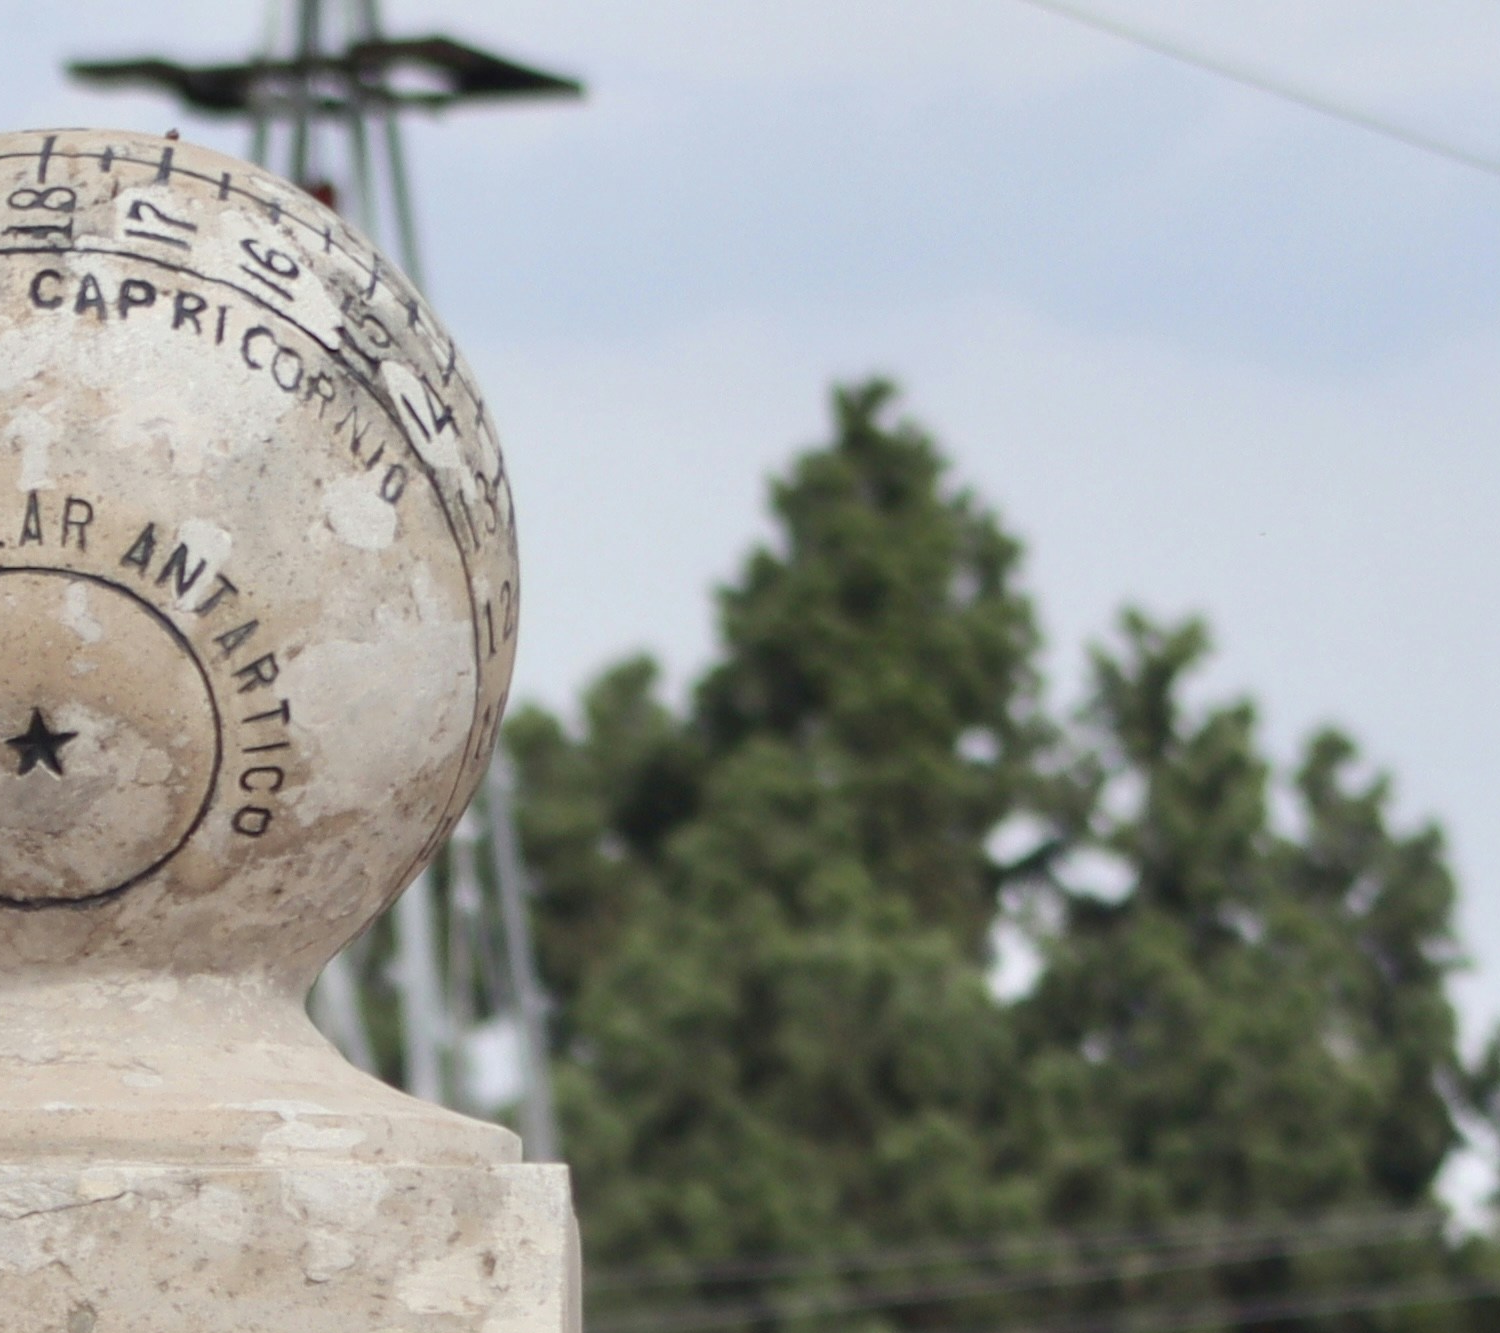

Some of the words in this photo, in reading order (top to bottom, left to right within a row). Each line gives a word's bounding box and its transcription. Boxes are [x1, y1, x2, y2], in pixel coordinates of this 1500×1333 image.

[4, 183, 80, 250] 18
[124, 196, 198, 249] 17
[239, 237, 300, 303] 16
[30, 268, 404, 507] CAPRICORNIO
